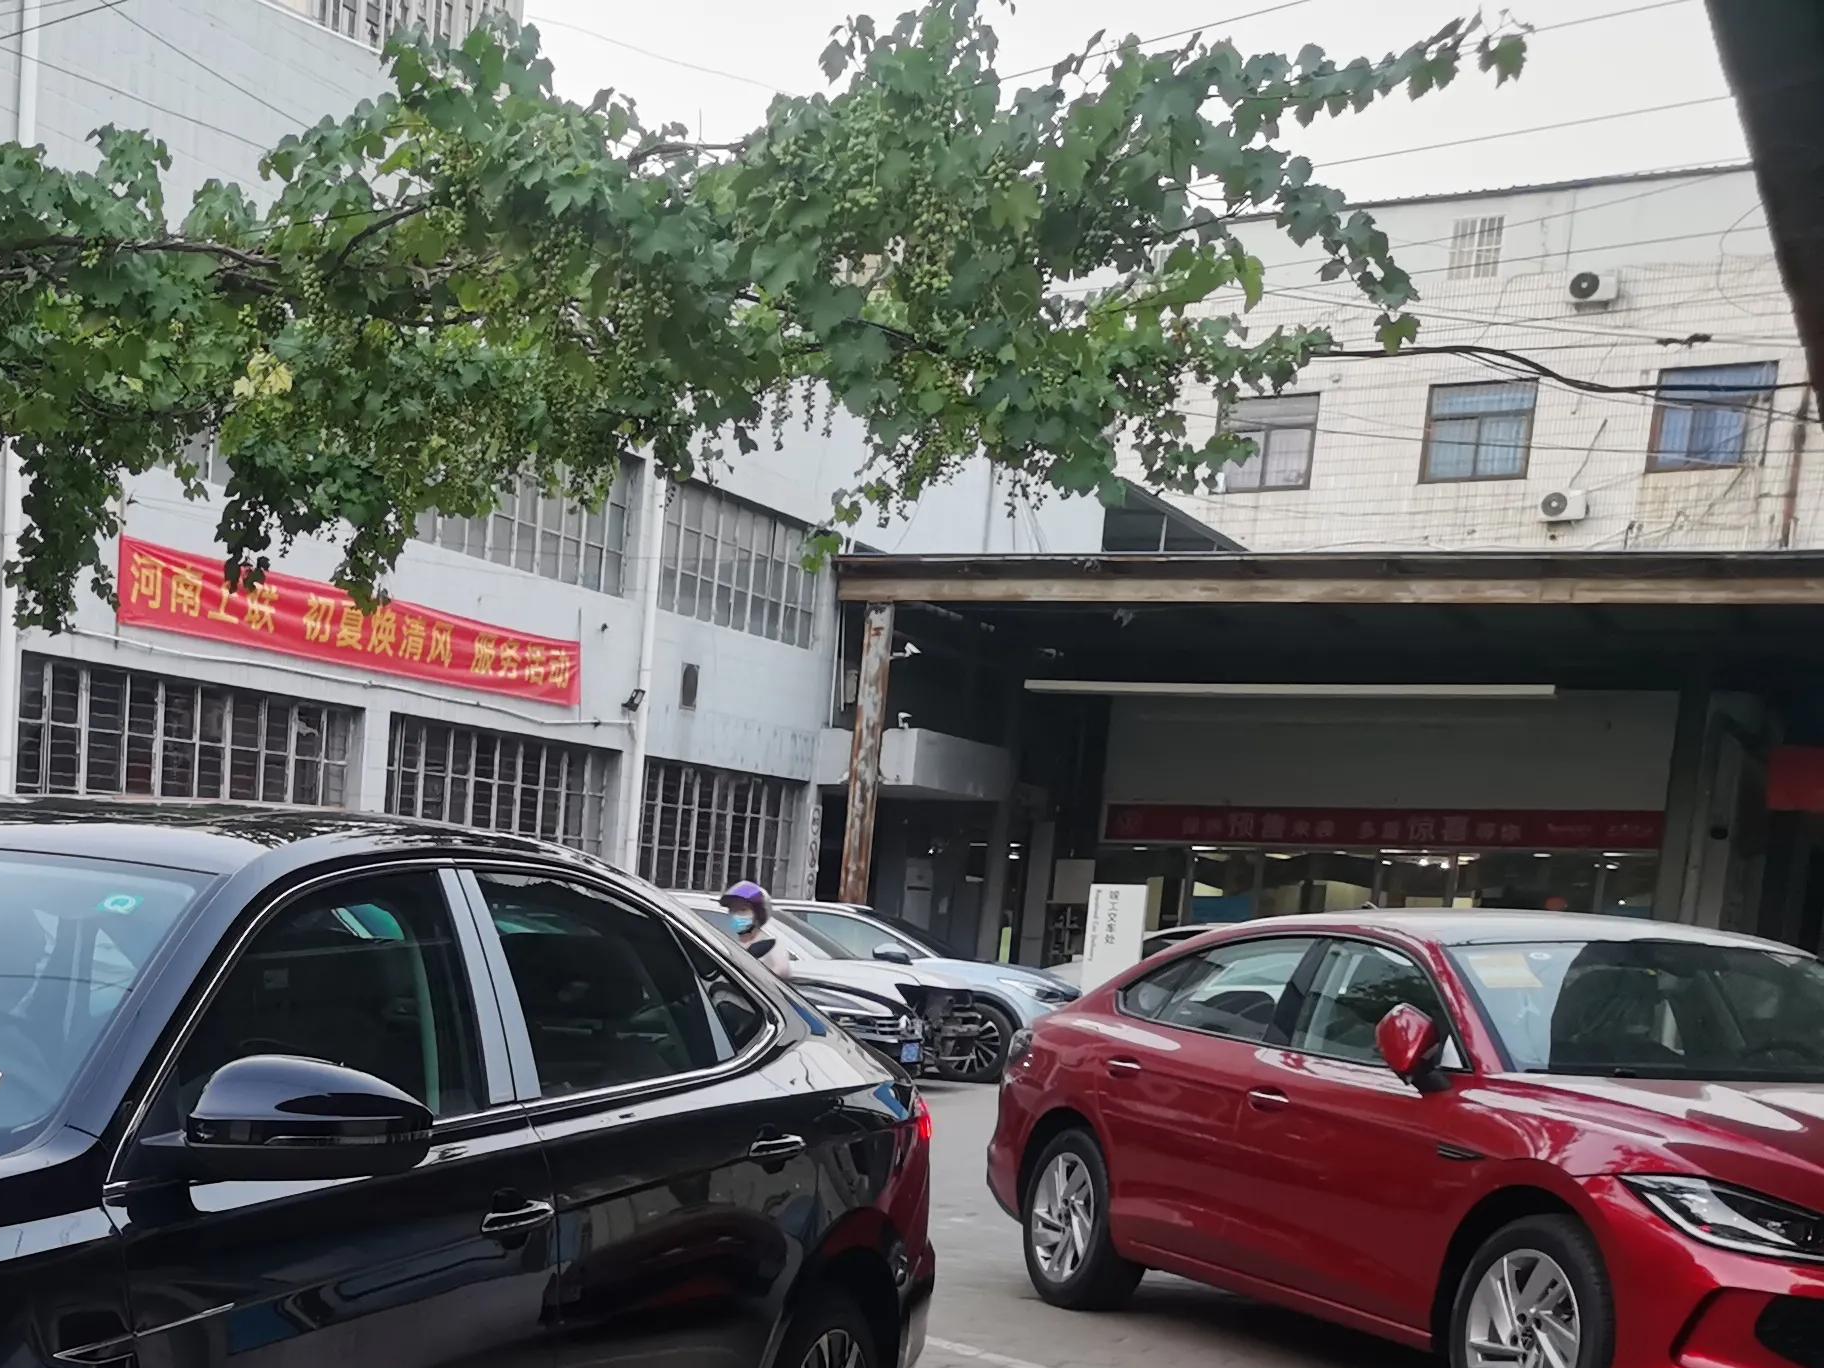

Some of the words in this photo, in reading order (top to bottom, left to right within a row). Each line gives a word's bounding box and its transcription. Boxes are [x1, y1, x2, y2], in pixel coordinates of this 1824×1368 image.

[130, 551, 280, 635] 河南上联
[302, 593, 455, 669] 初夏焕清风
[470, 631, 571, 690] 服务活动
